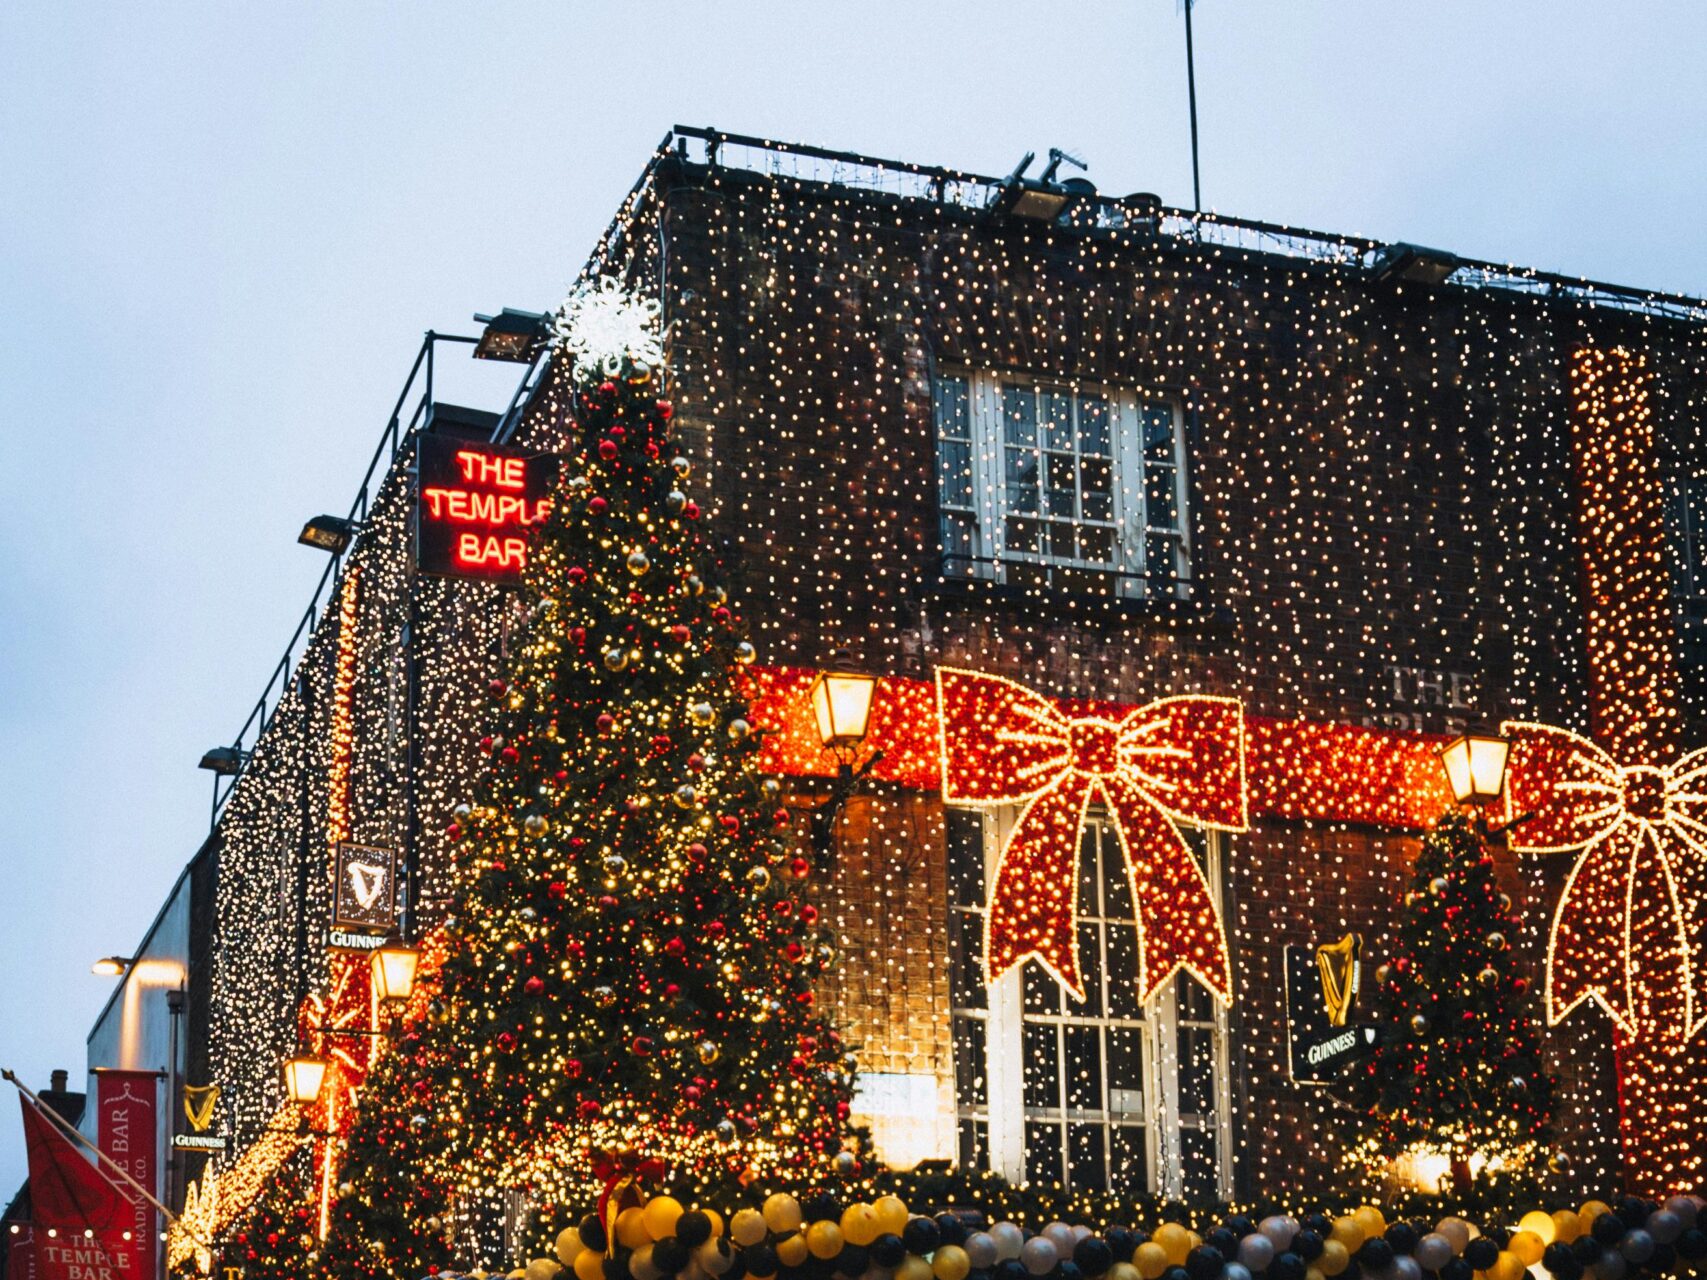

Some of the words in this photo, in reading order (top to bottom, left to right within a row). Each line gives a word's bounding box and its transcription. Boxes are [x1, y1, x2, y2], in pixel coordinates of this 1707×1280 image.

[457, 451, 525, 488] THE
[459, 533, 527, 567] BAR
[1308, 1030, 1356, 1065] GUINNESS
[112, 1108, 129, 1153] BAR
[175, 1134, 226, 1149] GUINNESS
